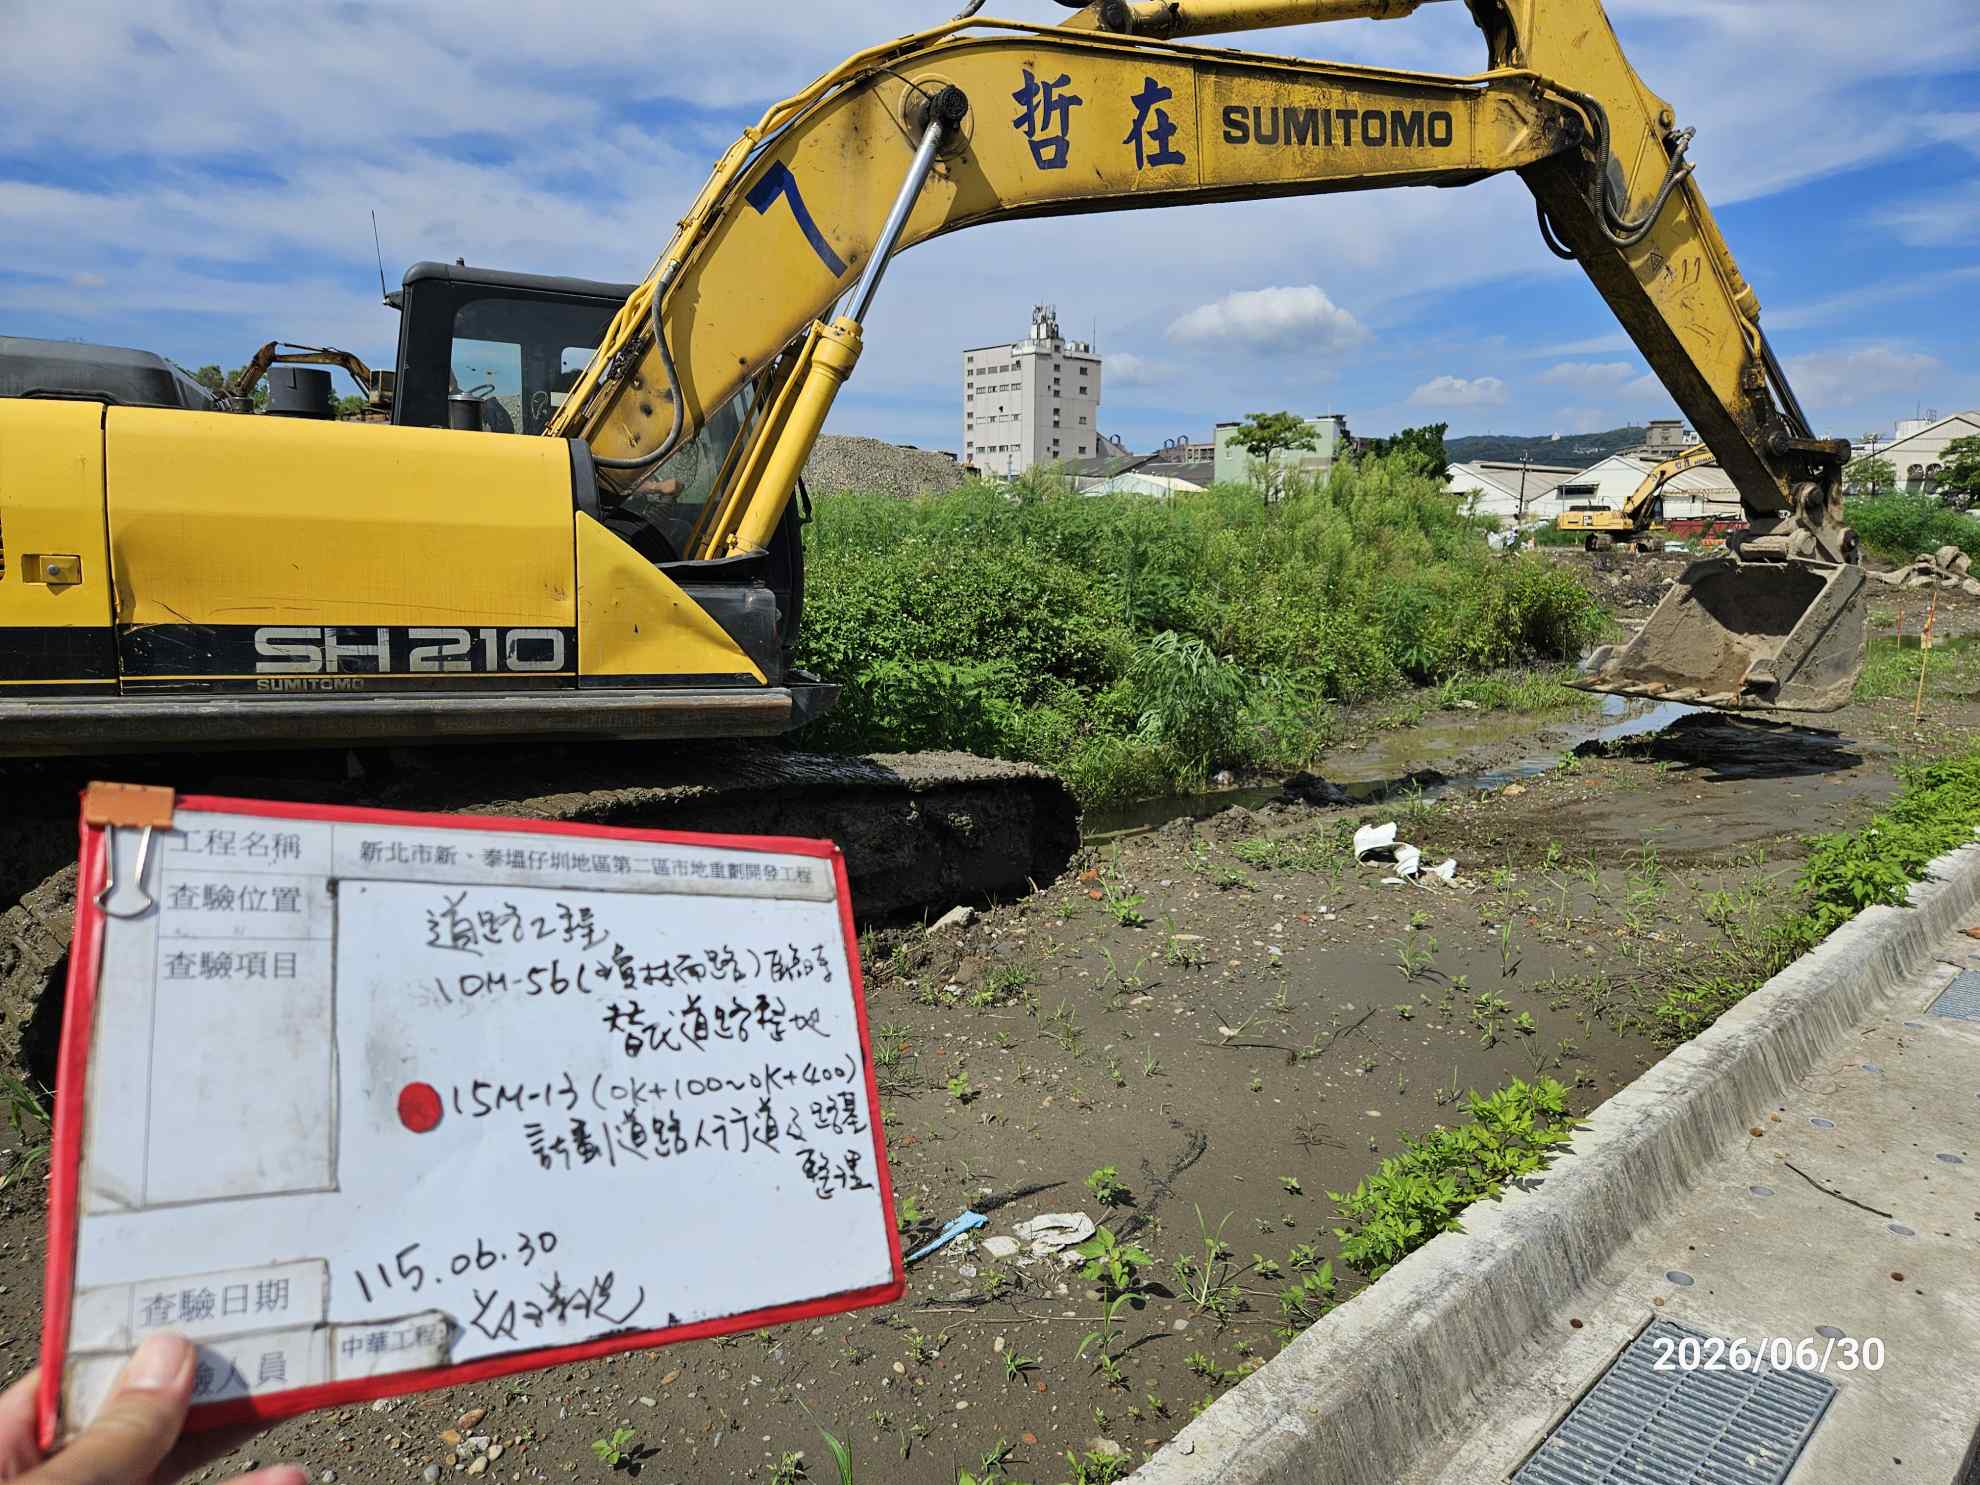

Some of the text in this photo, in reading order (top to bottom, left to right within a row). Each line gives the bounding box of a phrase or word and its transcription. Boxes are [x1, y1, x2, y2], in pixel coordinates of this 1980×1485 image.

[1222, 105, 1453, 148] SUMITOMO
[256, 678, 365, 692] SUMITOMO
[168, 828, 302, 860] 工程名稱
[166, 882, 303, 913] 查驗位置
[164, 951, 297, 981] 查驗項目
[354, 1231, 557, 1303] 115.06.30
[140, 1278, 290, 1330] 查驗日期
